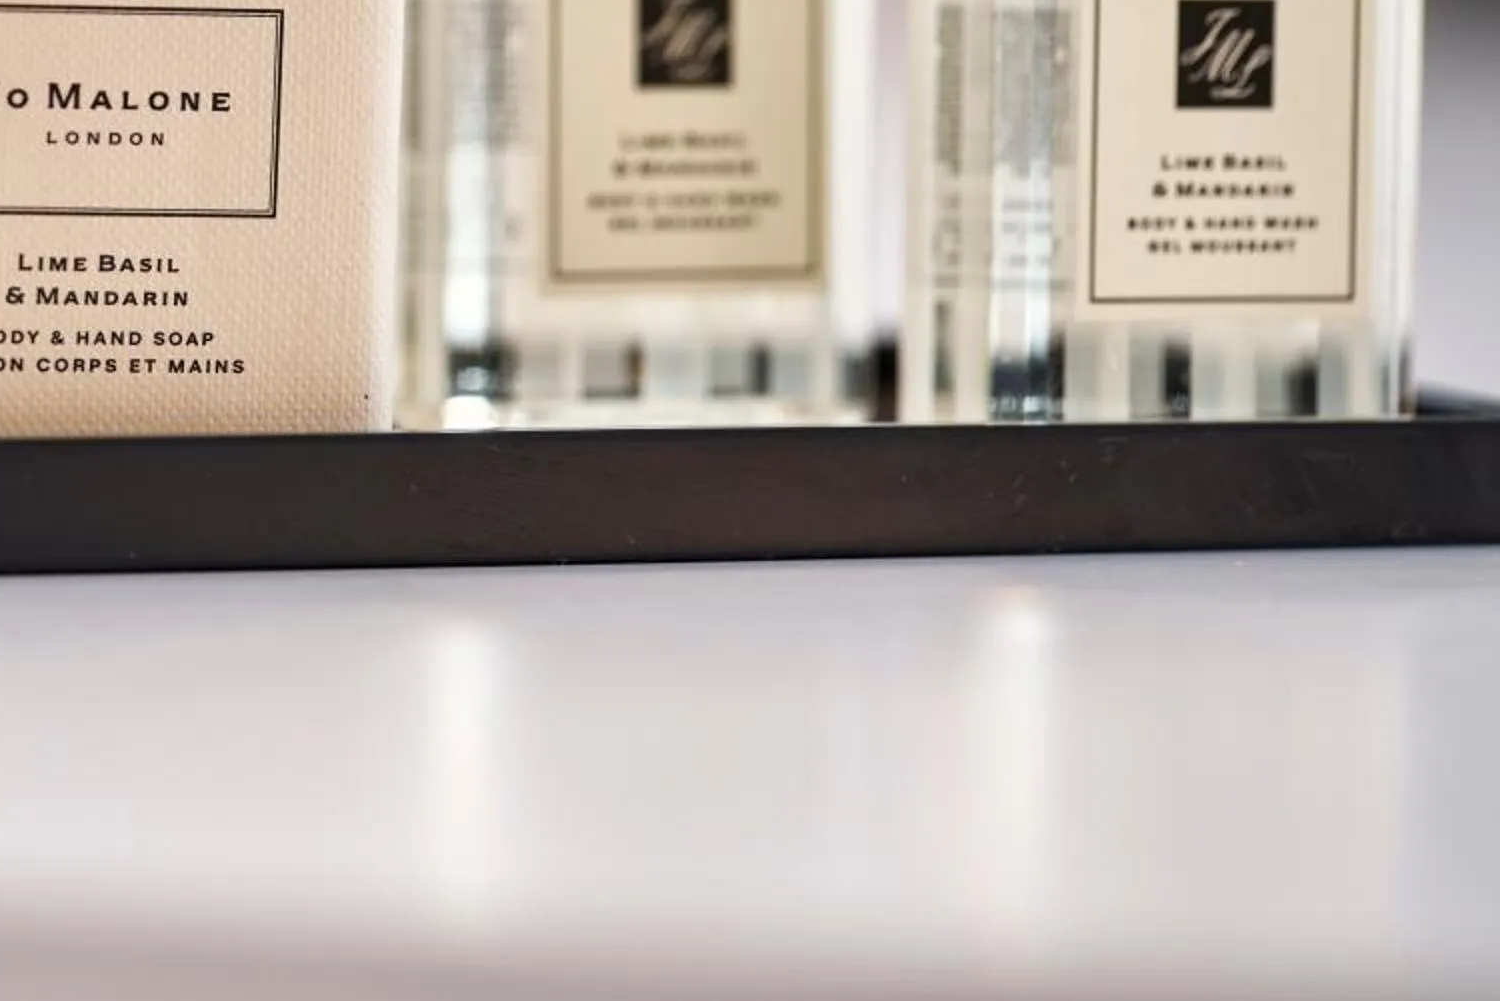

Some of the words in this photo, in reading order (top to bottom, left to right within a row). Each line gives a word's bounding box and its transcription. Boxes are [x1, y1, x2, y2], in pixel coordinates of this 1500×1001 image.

[47, 82, 231, 113] MALONE
[45, 130, 165, 147] LONDON
[18, 253, 88, 272] LIME
[98, 254, 180, 274] BASIL
[4, 285, 26, 305] &
[35, 286, 188, 307] MANDARIN
[50, 330, 65, 346] &
[75, 330, 143, 346] HAND
[153, 331, 215, 347] SOAP
[35, 357, 117, 374] CORPS
[128, 358, 157, 374] ET
[167, 358, 245, 374] MAINS
